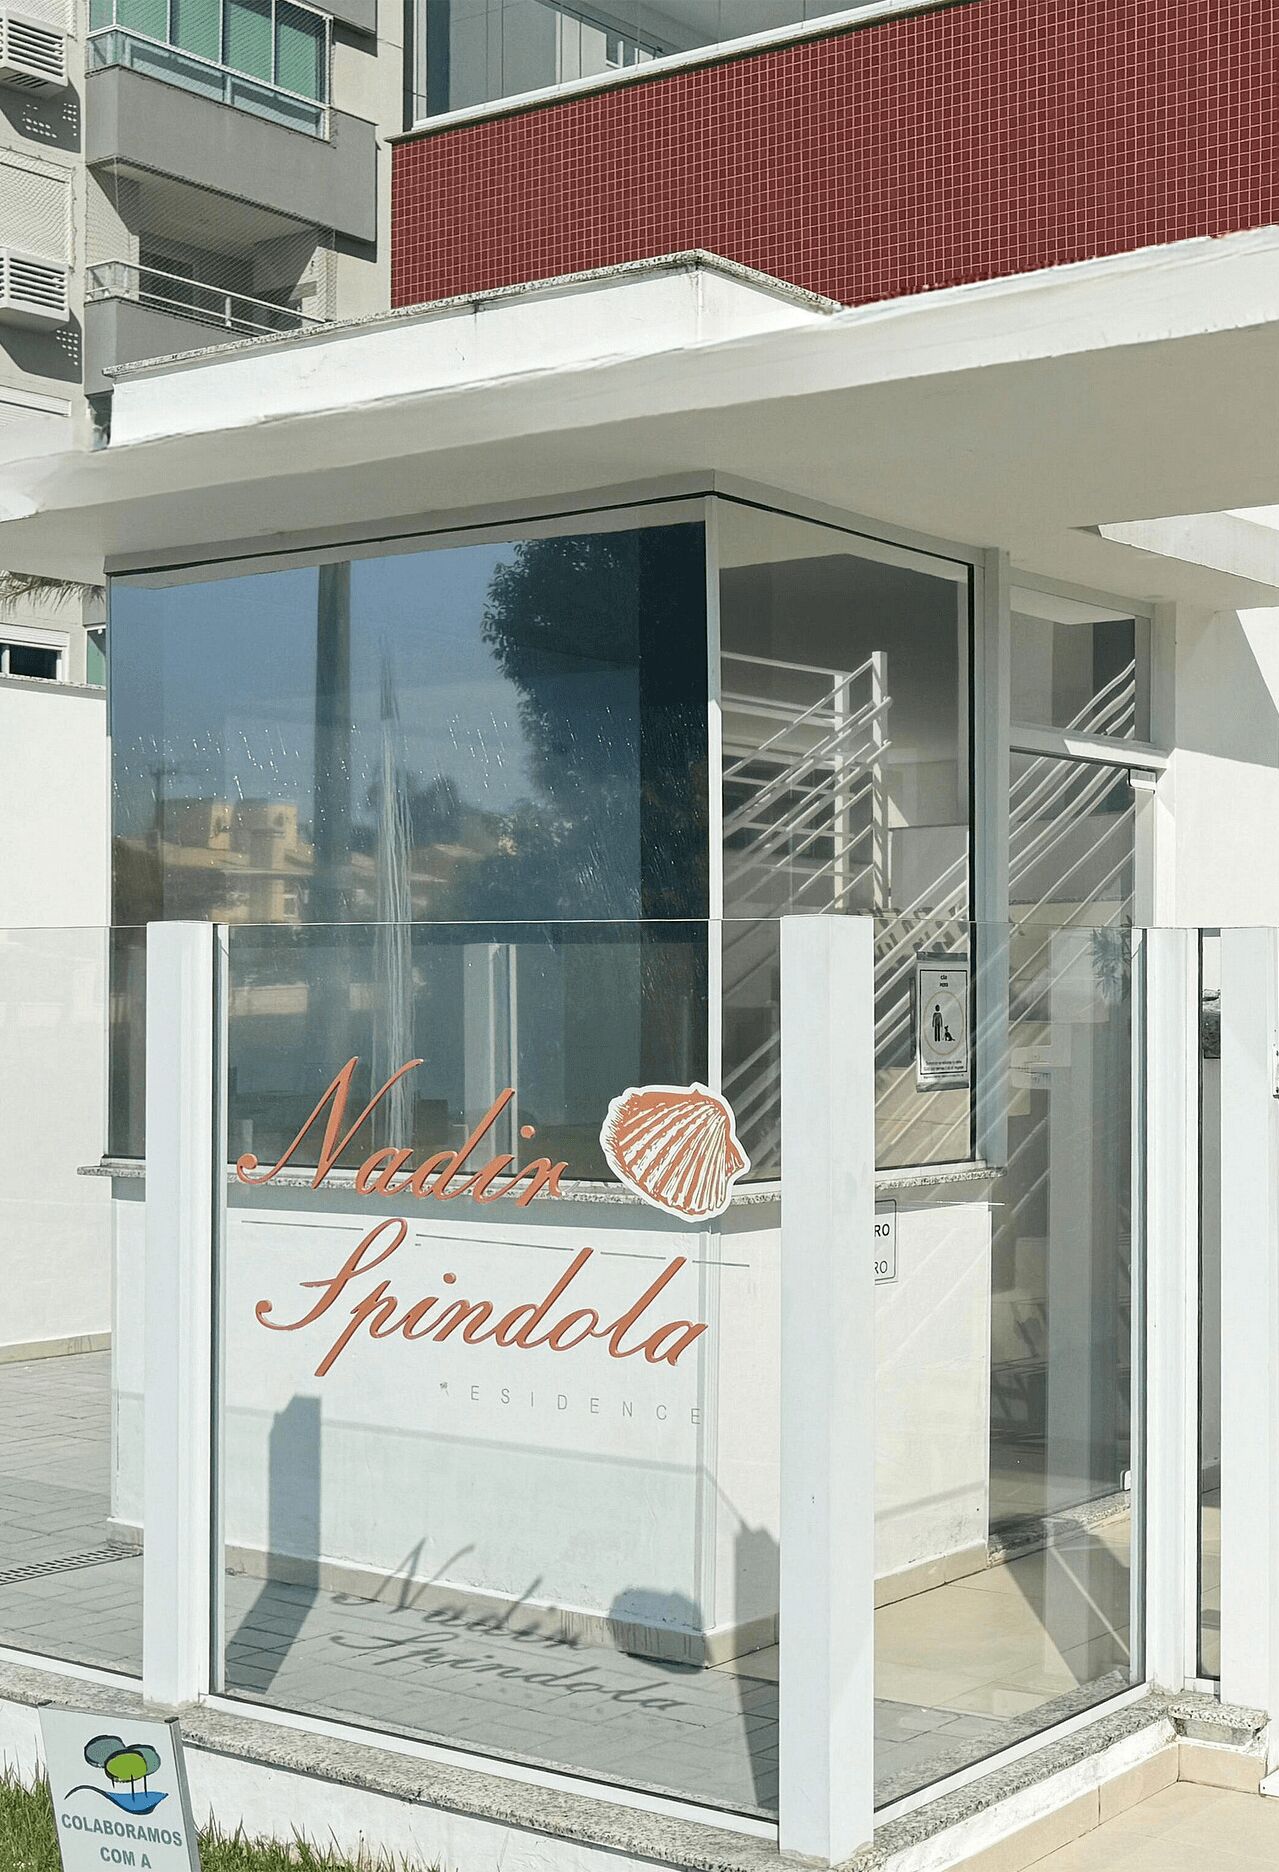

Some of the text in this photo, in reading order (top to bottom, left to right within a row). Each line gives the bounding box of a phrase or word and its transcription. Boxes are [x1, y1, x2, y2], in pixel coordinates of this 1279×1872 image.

[236, 1056, 569, 1207] Nadir
[255, 1218, 708, 1377] Spindola
[61, 1813, 183, 1847] COLABORAMOS
[100, 1846, 152, 1869] COM A
